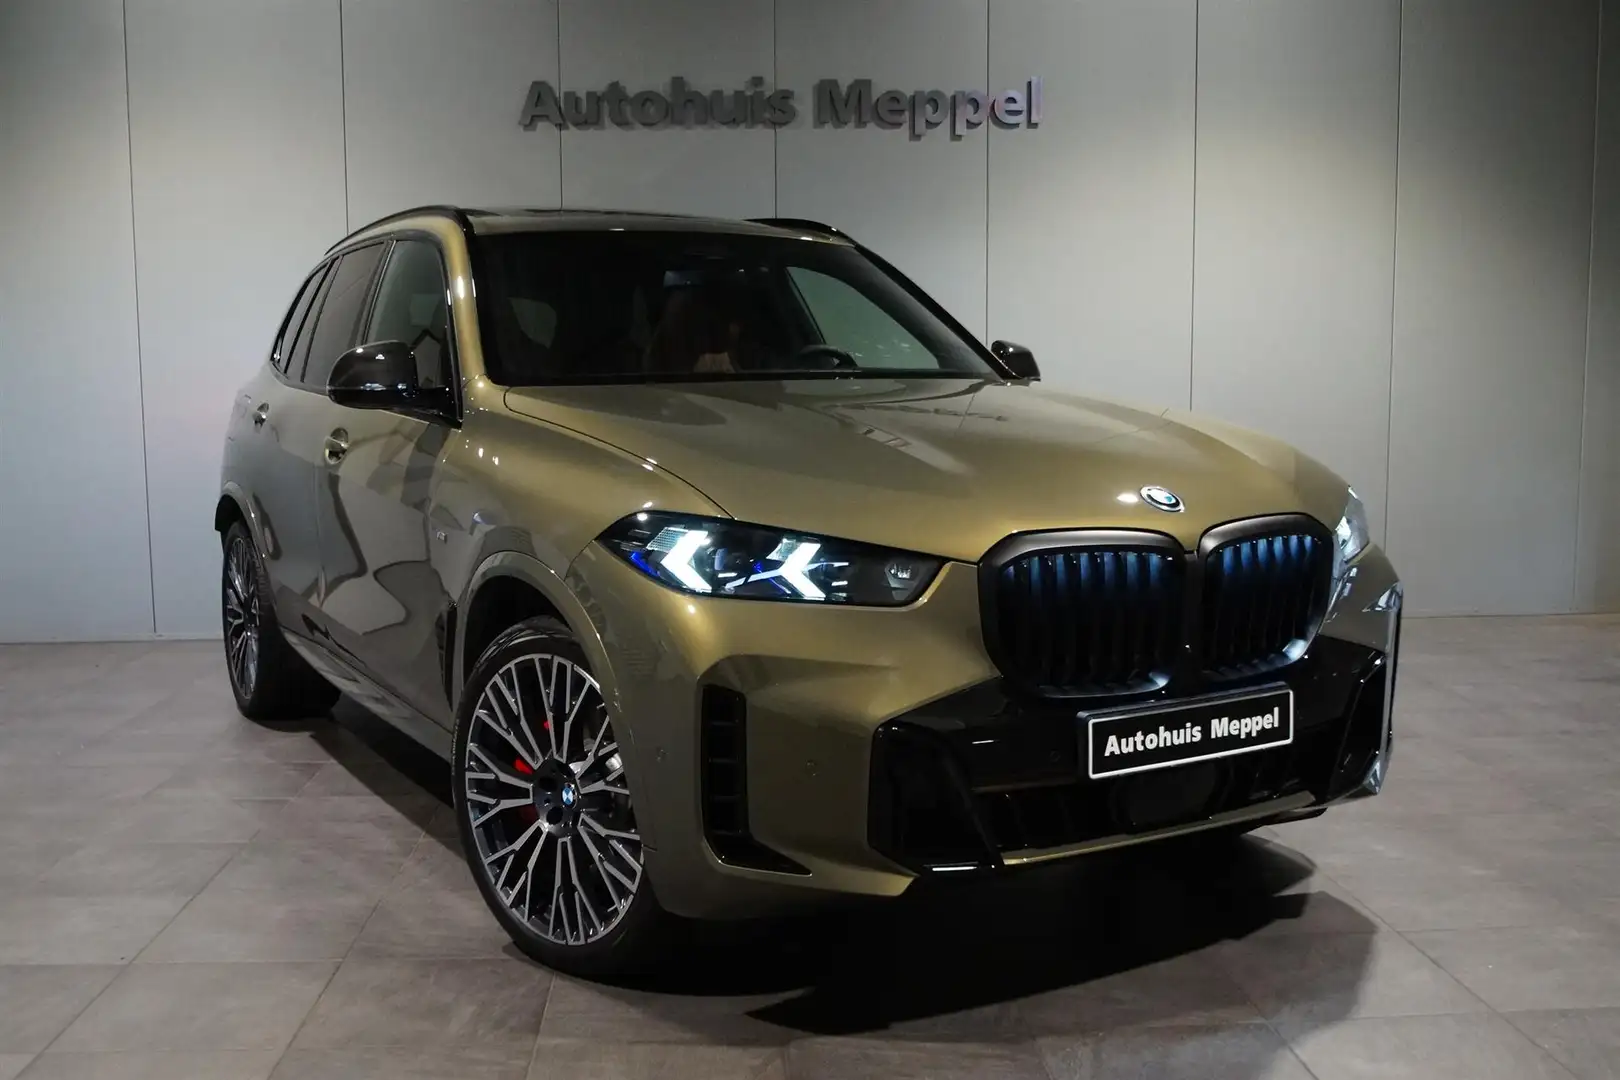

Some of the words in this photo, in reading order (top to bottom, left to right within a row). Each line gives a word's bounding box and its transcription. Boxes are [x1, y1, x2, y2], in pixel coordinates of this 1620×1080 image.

[519, 77, 795, 130] Autohuis
[813, 75, 1043, 141] Meppel
[1104, 722, 1201, 756] Autohuis
[1211, 707, 1279, 738] Meppel
